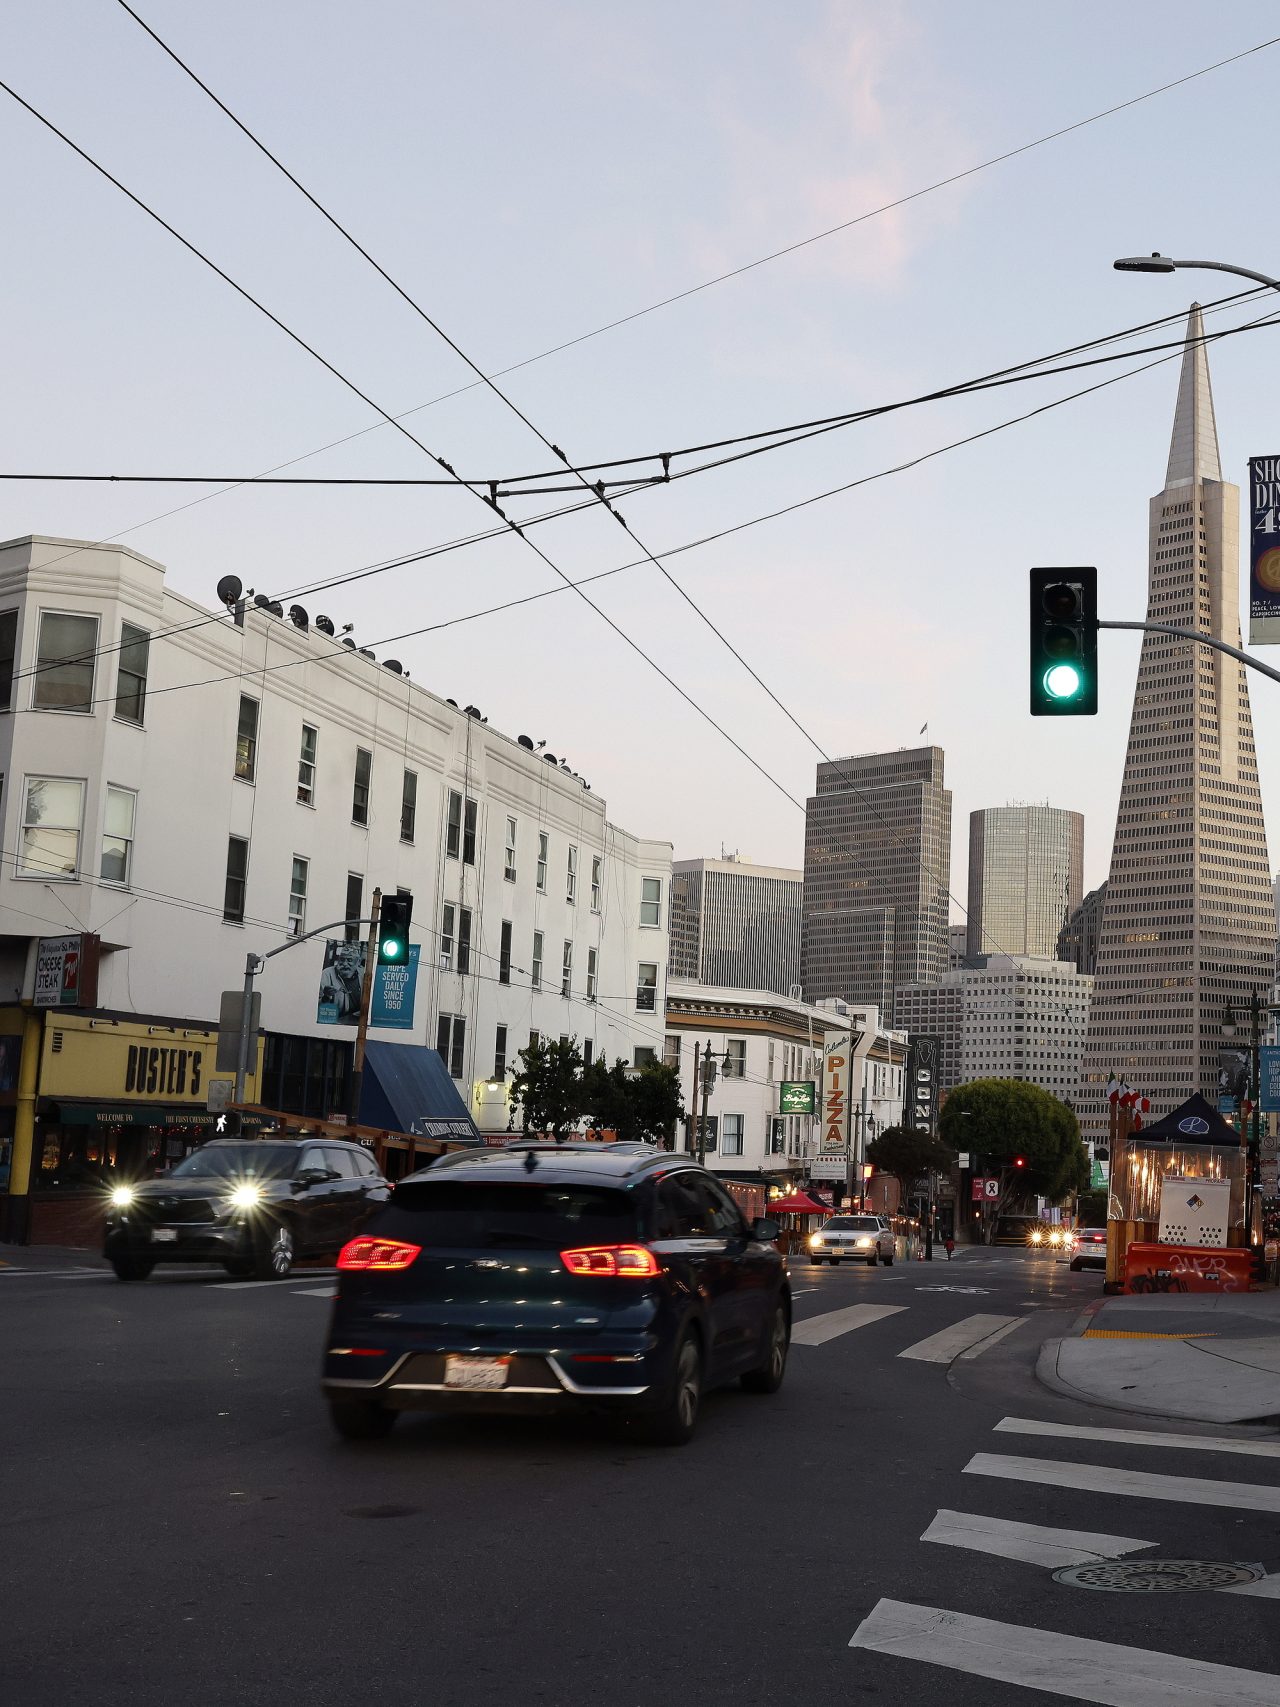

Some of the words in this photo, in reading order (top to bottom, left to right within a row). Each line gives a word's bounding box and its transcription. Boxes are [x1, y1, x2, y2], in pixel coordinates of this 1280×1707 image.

[38, 956, 62, 972] CHEESE
[38, 973, 59, 988] STEAK
[382, 972, 409, 982] SERVED
[385, 982, 404, 990] DAILY
[383, 991, 404, 1000] SINCE
[385, 1000, 401, 1010] 1950
[125, 1044, 202, 1095] BUSTER'S
[826, 1056, 845, 1142] PIZZA
[96, 1114, 124, 1122] WELCOME
